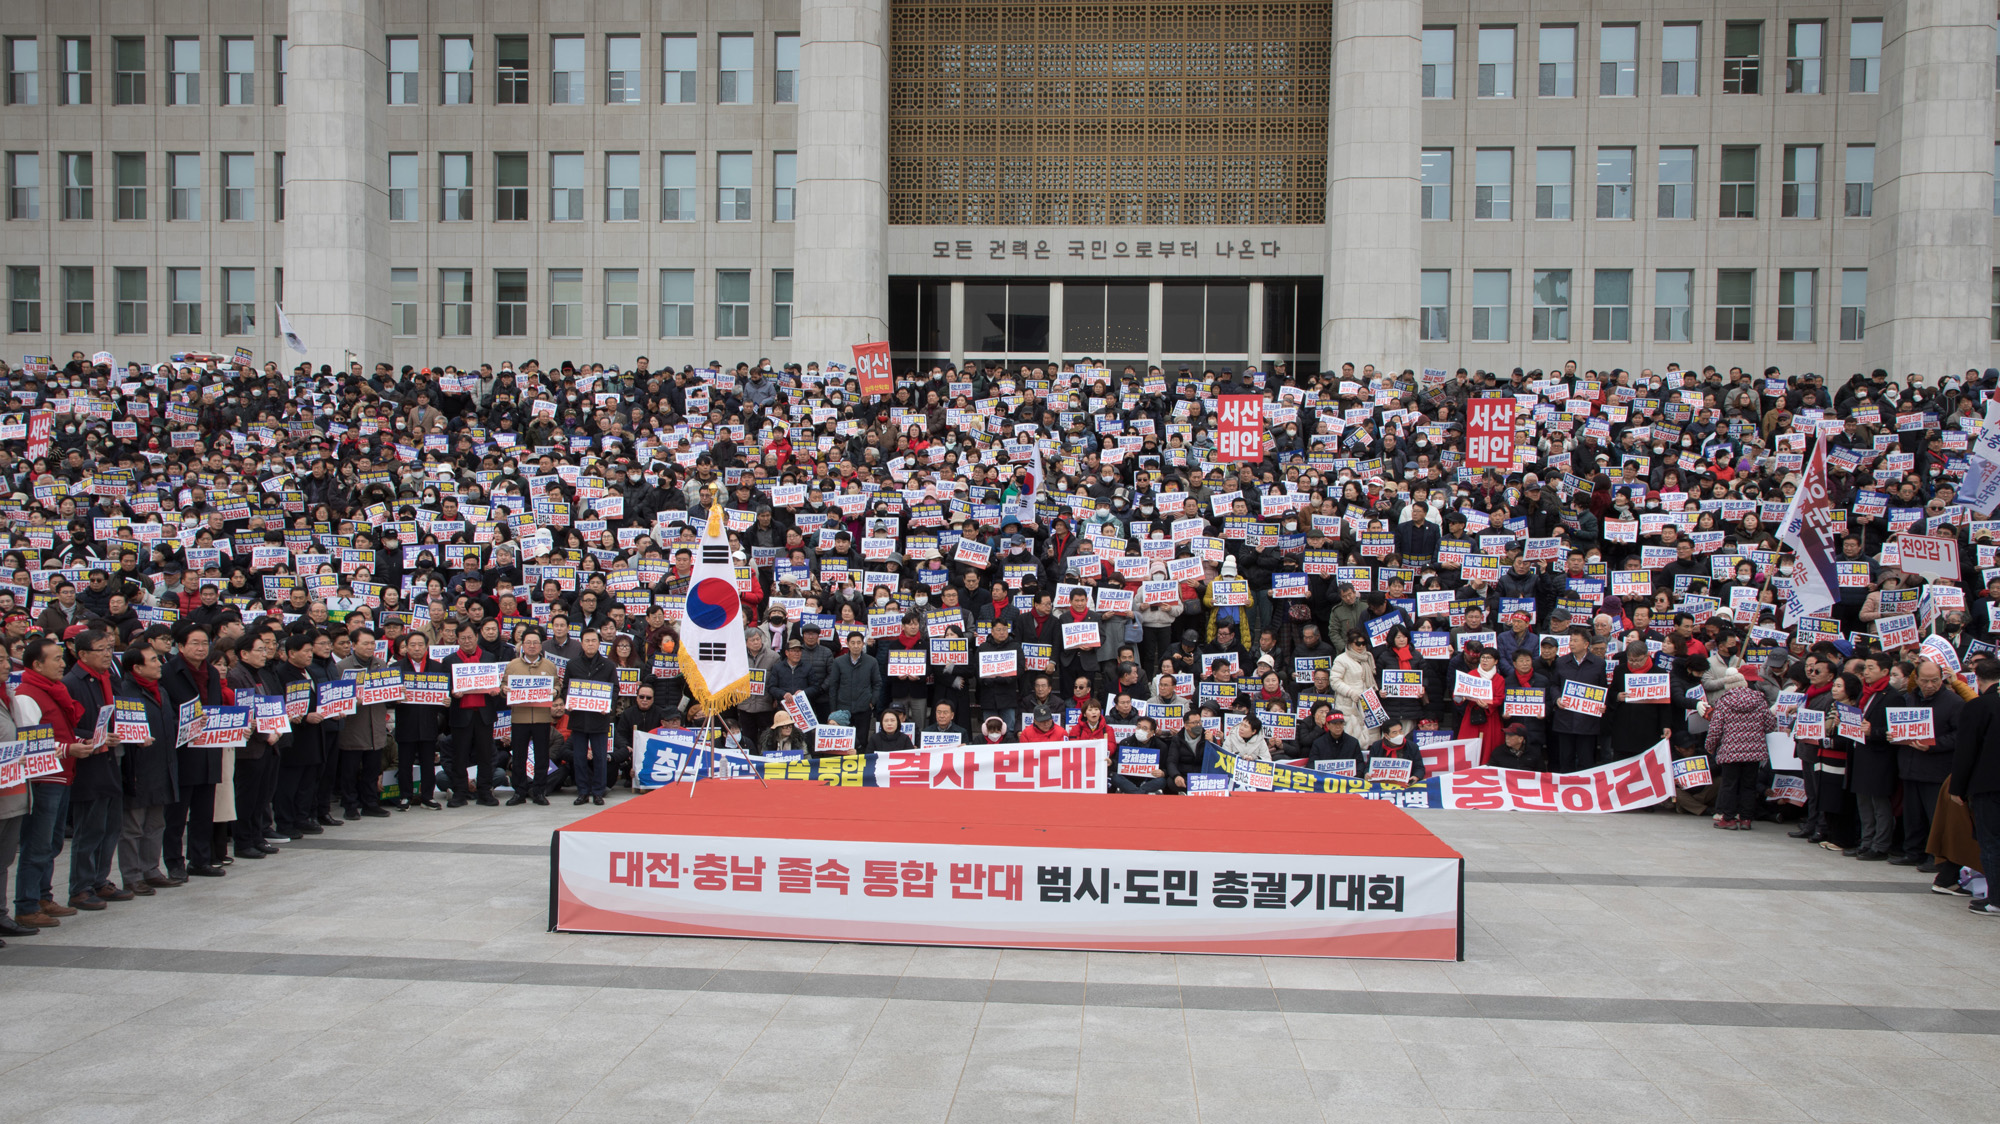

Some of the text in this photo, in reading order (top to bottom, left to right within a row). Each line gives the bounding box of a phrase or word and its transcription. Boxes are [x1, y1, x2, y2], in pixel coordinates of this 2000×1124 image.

[933, 240, 1280, 260] 모든 권력은 국민으로부터 나온다
[858, 352, 888, 379] 예산
[1220, 400, 1260, 426] 서산
[1470, 404, 1512, 431] 서산
[30, 417, 50, 440] 서산
[1220, 431, 1260, 456] 태안
[1468, 436, 1511, 462] 태안
[1902, 538, 1952, 561] 천안갑 1
[1186, 566, 1200, 577] 반대!
[1304, 564, 1336, 574] 중단하라
[1462, 569, 1498, 580] 결사 반대!
[1274, 576, 1305, 588] 강제합병
[1851, 575, 1869, 586] 반대!
[1612, 584, 1650, 594] 결사 반대!
[1145, 590, 1176, 602] 결사 반대!
[1098, 600, 1130, 610] 결사 반대!
[1502, 602, 1534, 612] 강제합병
[1800, 619, 1812, 630] 주민
[1813, 620, 1819, 630] 뜻
[872, 626, 885, 636] 결사
[1066, 632, 1097, 645] 결사 반대!
[1414, 636, 1447, 646] 강제합병
[1798, 632, 1814, 643] 정치쇼
[1883, 630, 1916, 646] 결사 반대!
[932, 653, 967, 664] 결사 반대!
[456, 666, 468, 674] 주민
[471, 665, 476, 673] 뜻
[890, 664, 924, 673] 중단하라
[1296, 660, 1306, 670] 주민
[1308, 660, 1313, 669] 뜻
[511, 678, 551, 686] 주민 뜻 짓밟는
[1384, 672, 1396, 682] 주민
[1397, 672, 1402, 682] 뜻
[456, 678, 472, 689] 정치쇼
[321, 685, 353, 702] 강제합병
[364, 686, 402, 703] 중단하라
[1202, 685, 1212, 694] 주민
[1213, 686, 1218, 694] 뜻
[1384, 685, 1398, 696] 정치쇼
[1456, 683, 1490, 698] 결사 반대!
[1628, 686, 1666, 698] 결사 반대!
[406, 690, 448, 703] 중단하라
[510, 690, 526, 701] 정치쇼
[320, 700, 352, 718] 결사반대
[568, 697, 609, 710] 중단하라
[1506, 704, 1542, 714] 중단하라
[1562, 696, 1602, 714] 결사 반대!
[1262, 714, 1270, 723] 주민
[1272, 715, 1278, 724] 뜻
[116, 723, 149, 740] 중단하라
[1890, 723, 1930, 738] 결사 반대!
[818, 738, 852, 748] 결사 반대!
[1122, 752, 1156, 764] 강제합병
[888, 752, 978, 788] 결사
[994, 748, 1096, 789] 반대!
[1120, 764, 1156, 774] 결사반대
[1236, 761, 1248, 770] 주민
[1250, 763, 1254, 772] 뜻
[1234, 771, 1248, 784] 정치쇼
[1371, 770, 1408, 779] 결사 반대!
[1690, 770, 1710, 786] 반대!
[1190, 780, 1226, 790] 강제합병
[1452, 750, 1666, 812] 중단하라
[609, 851, 1404, 912] 대전·충남 졸속 통합 반대 범시·도민 총궐기대회
